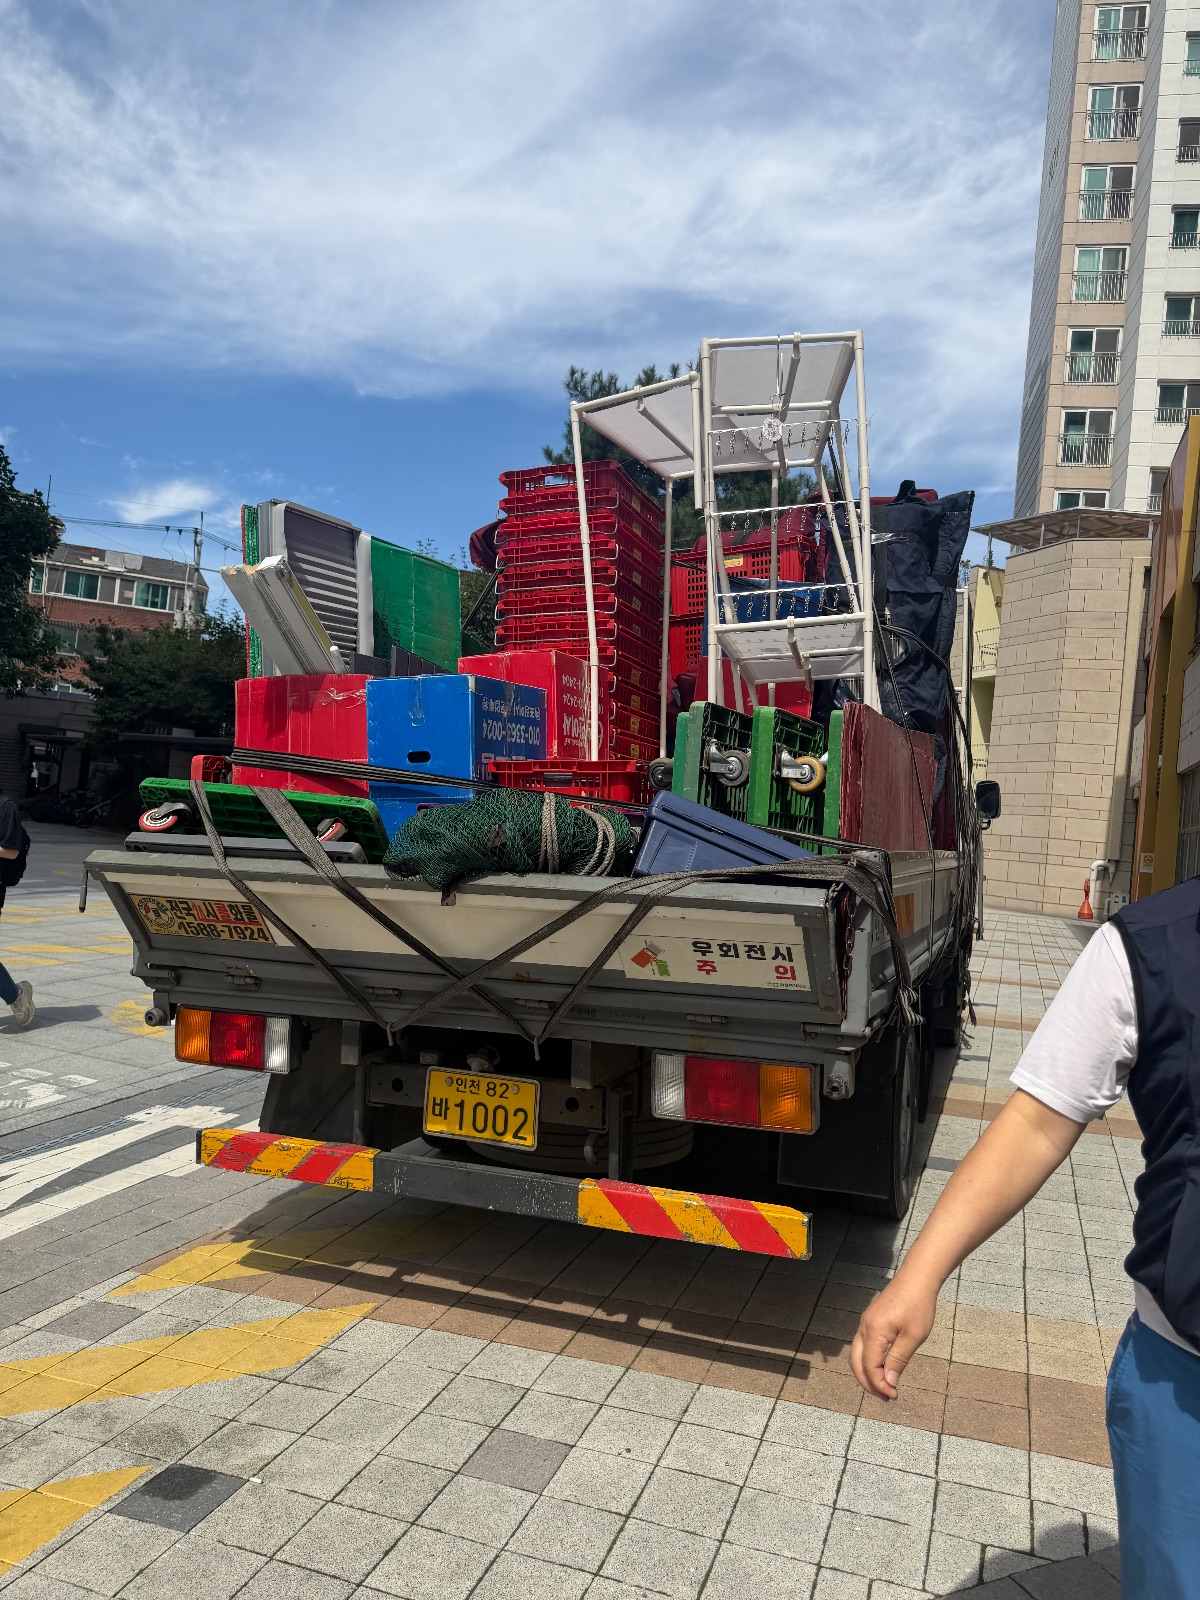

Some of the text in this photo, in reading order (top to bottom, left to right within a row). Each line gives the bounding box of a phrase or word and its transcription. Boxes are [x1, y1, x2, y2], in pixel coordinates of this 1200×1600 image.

[482, 719, 540, 746] 010-3363-0024
[178, 921, 270, 942] 1588-7924
[455, 1077, 510, 1100] 인천 82
